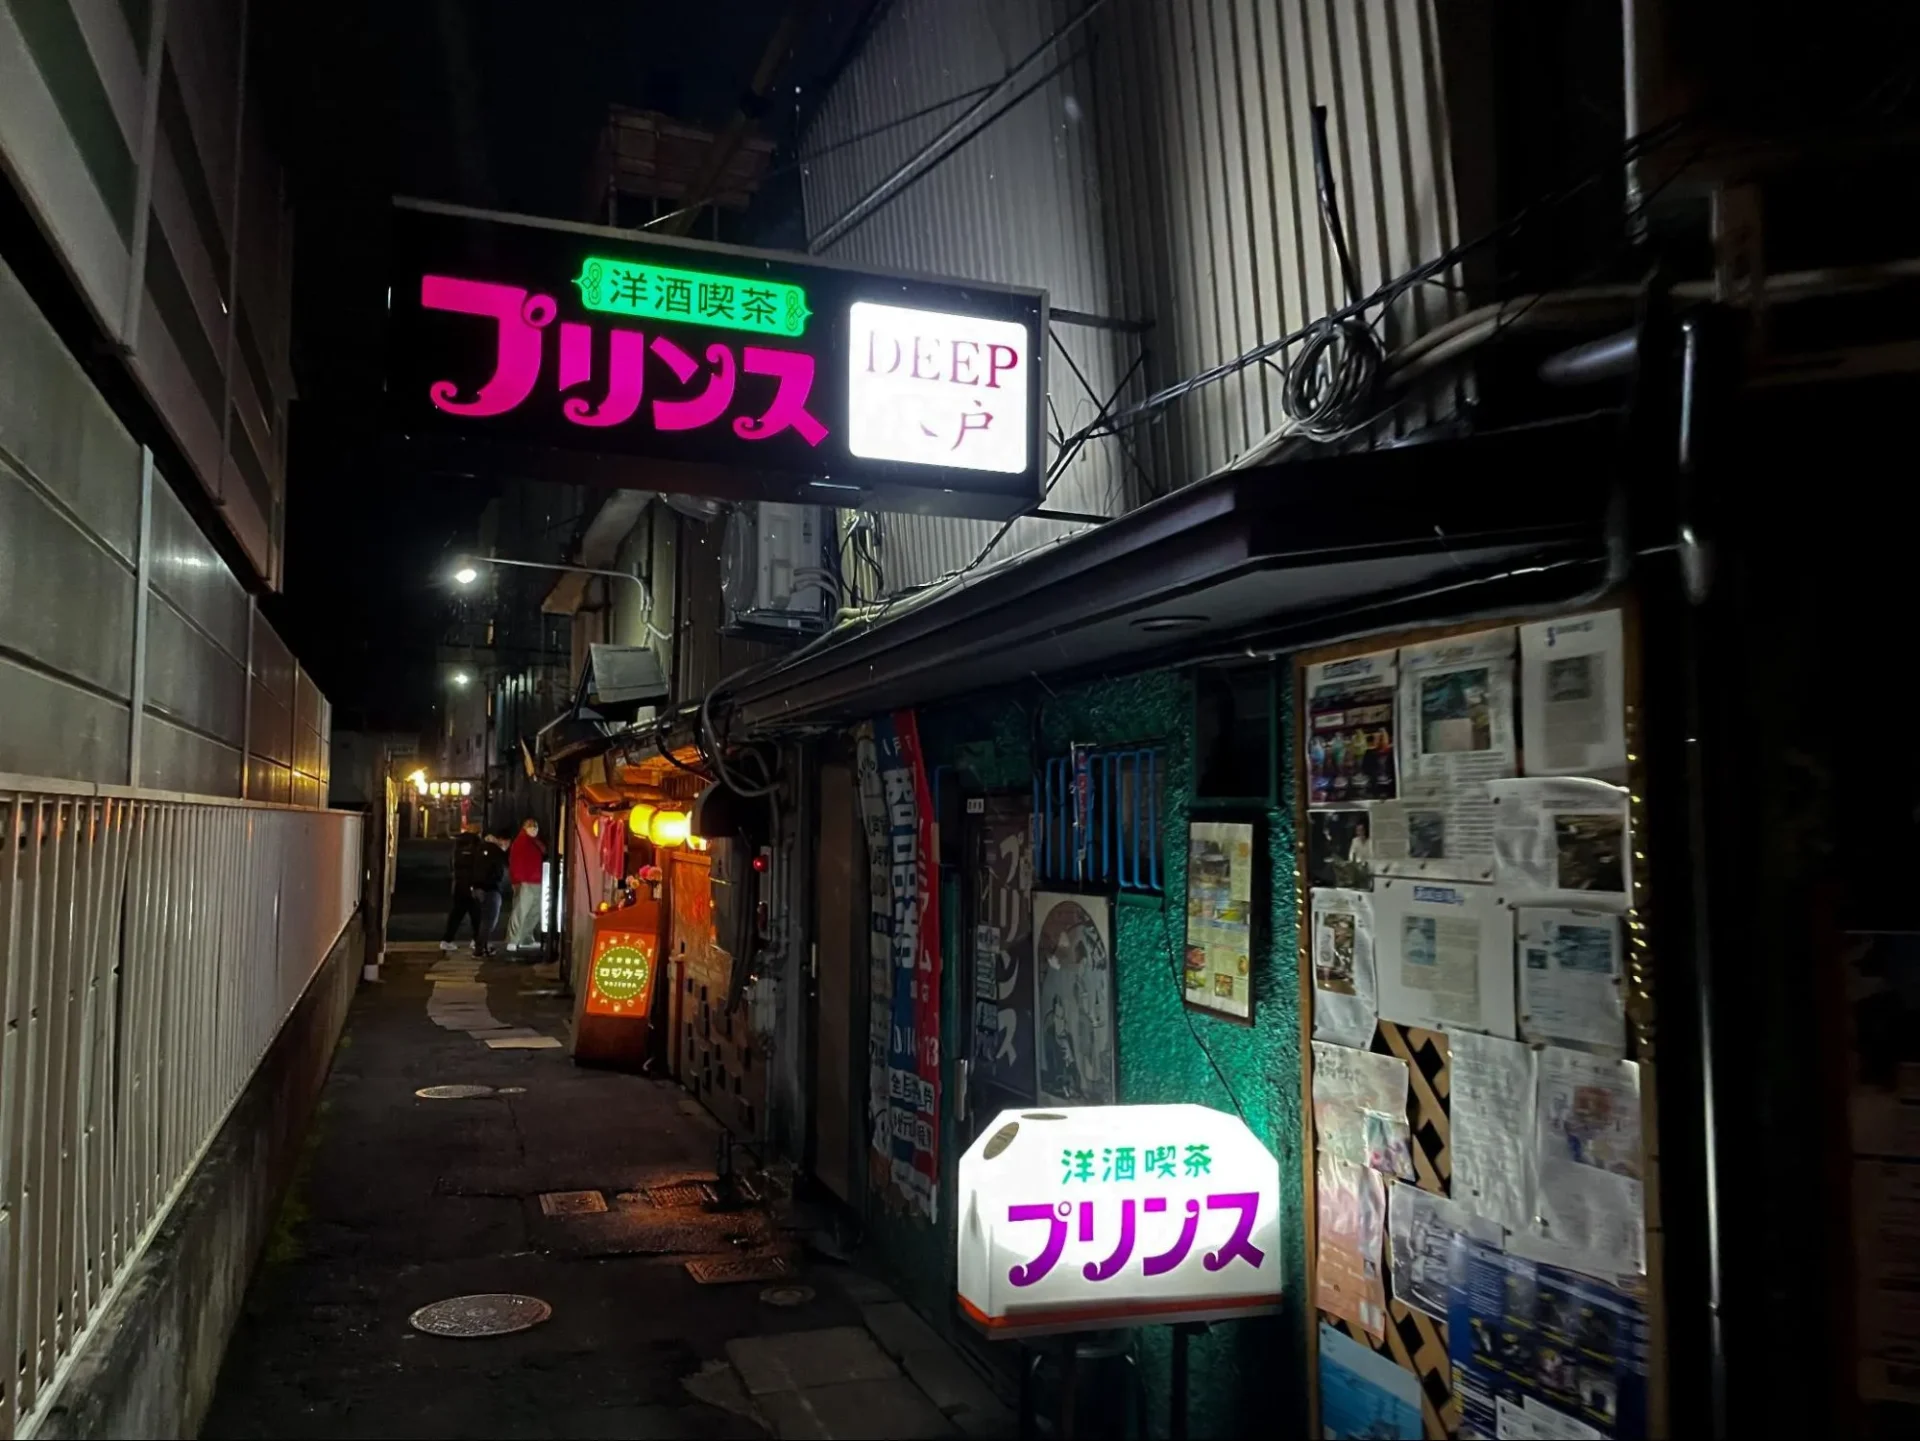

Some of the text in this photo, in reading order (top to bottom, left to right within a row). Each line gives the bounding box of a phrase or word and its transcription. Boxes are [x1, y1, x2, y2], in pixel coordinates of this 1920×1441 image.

[608, 267, 778, 326] 洋酒喫茶
[421, 275, 829, 447] プリンス
[866, 330, 1019, 389] DEEP
[599, 967, 645, 980] ロジウラ
[1061, 1144, 1213, 1185] 洋酒喫茶
[1008, 1192, 1265, 1287] プリンス
